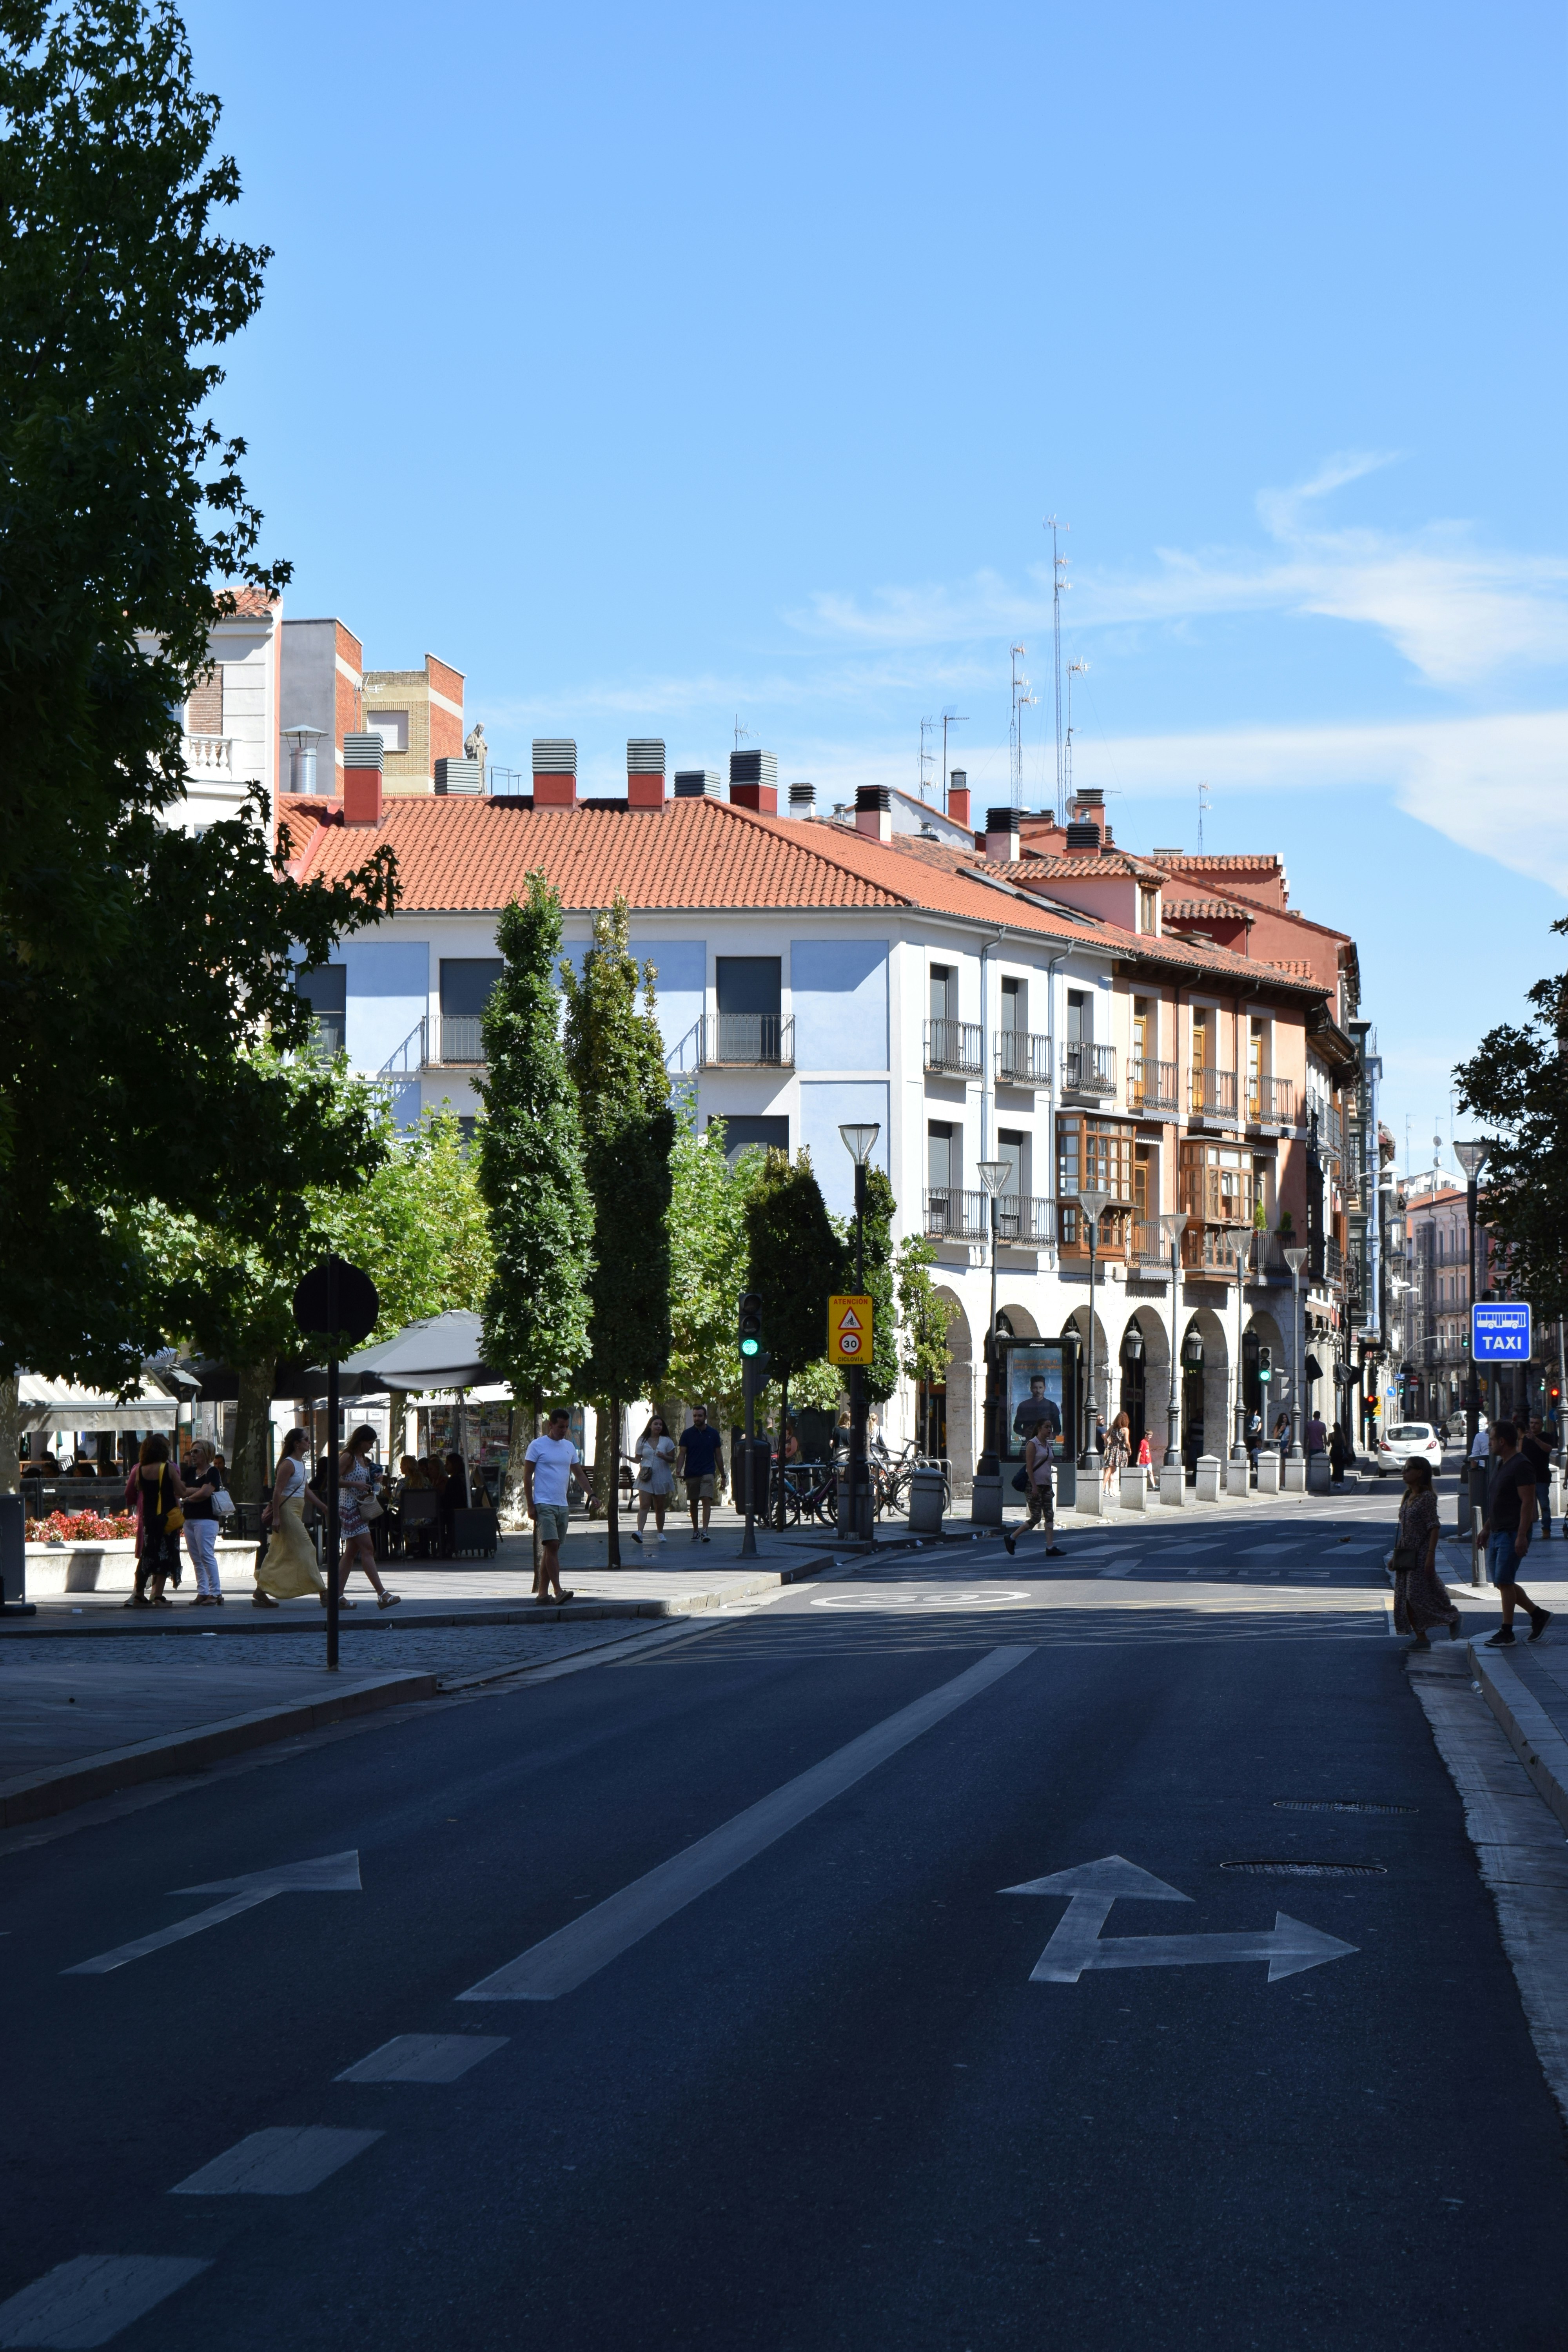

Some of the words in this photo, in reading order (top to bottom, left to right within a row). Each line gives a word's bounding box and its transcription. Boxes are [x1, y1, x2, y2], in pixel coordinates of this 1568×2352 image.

[844, 1340, 857, 1348] 30
[1482, 1336, 1521, 1349] TAXI
[860, 1594, 980, 1604] 30
